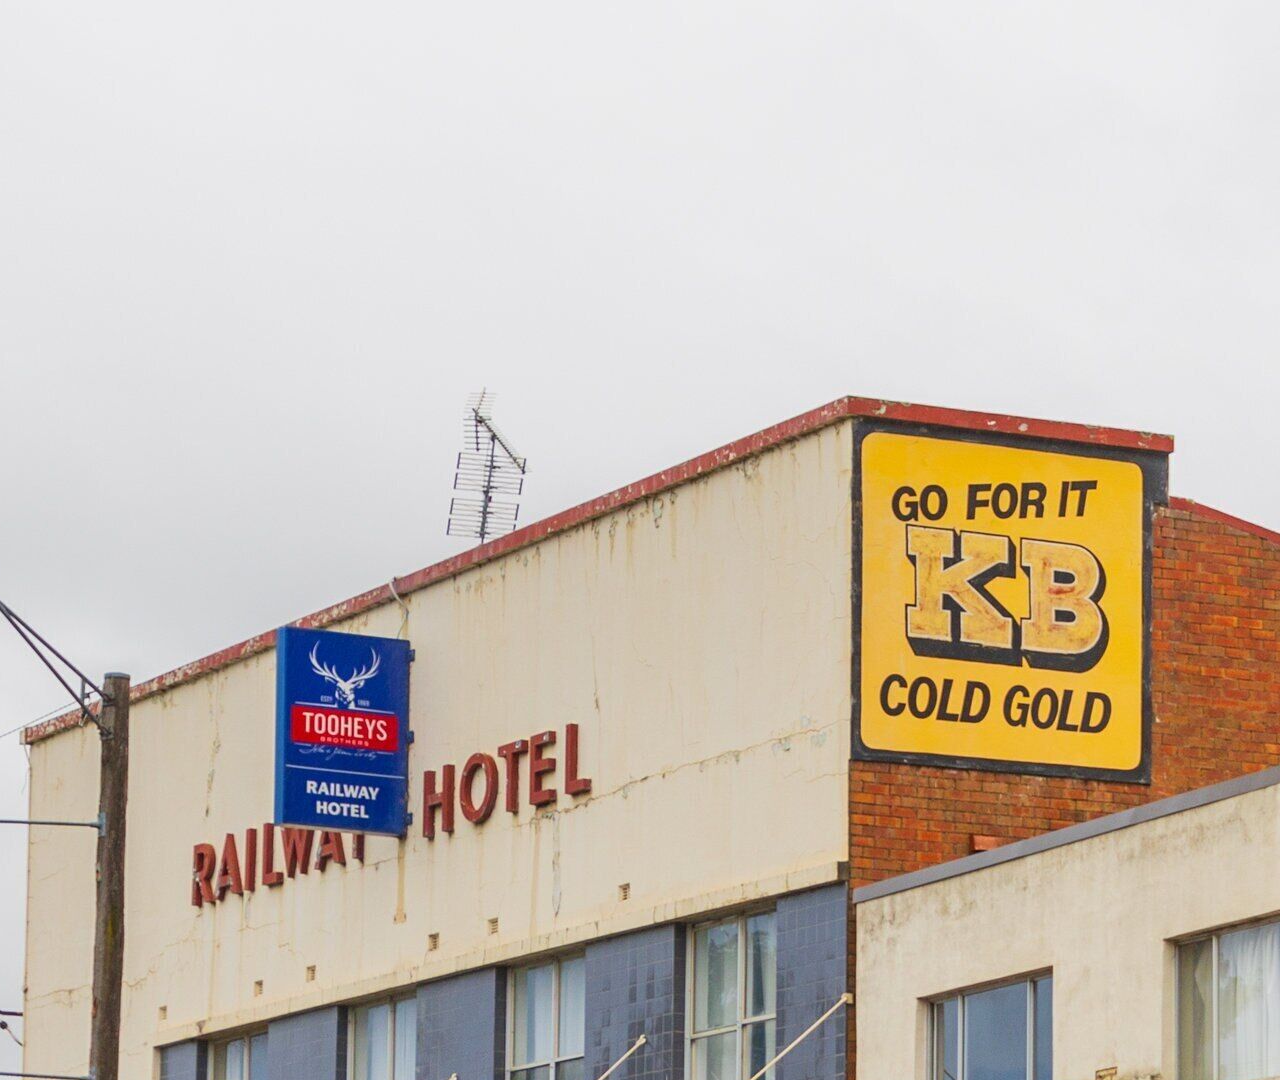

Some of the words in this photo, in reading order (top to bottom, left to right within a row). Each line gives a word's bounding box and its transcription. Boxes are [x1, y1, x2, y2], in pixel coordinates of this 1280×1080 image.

[891, 484, 948, 522] GO
[966, 481, 1047, 520] FOR
[1058, 480, 1098, 517] IT
[906, 524, 1109, 673] KB
[880, 673, 991, 723] COLD
[1003, 684, 1112, 734] GOLD
[302, 711, 388, 741] TOOHEYS
[320, 736, 370, 747] BROTHERS
[306, 780, 380, 801] RAILWAY
[422, 722, 592, 840] HOTEL
[315, 801, 370, 819] HOTEL
